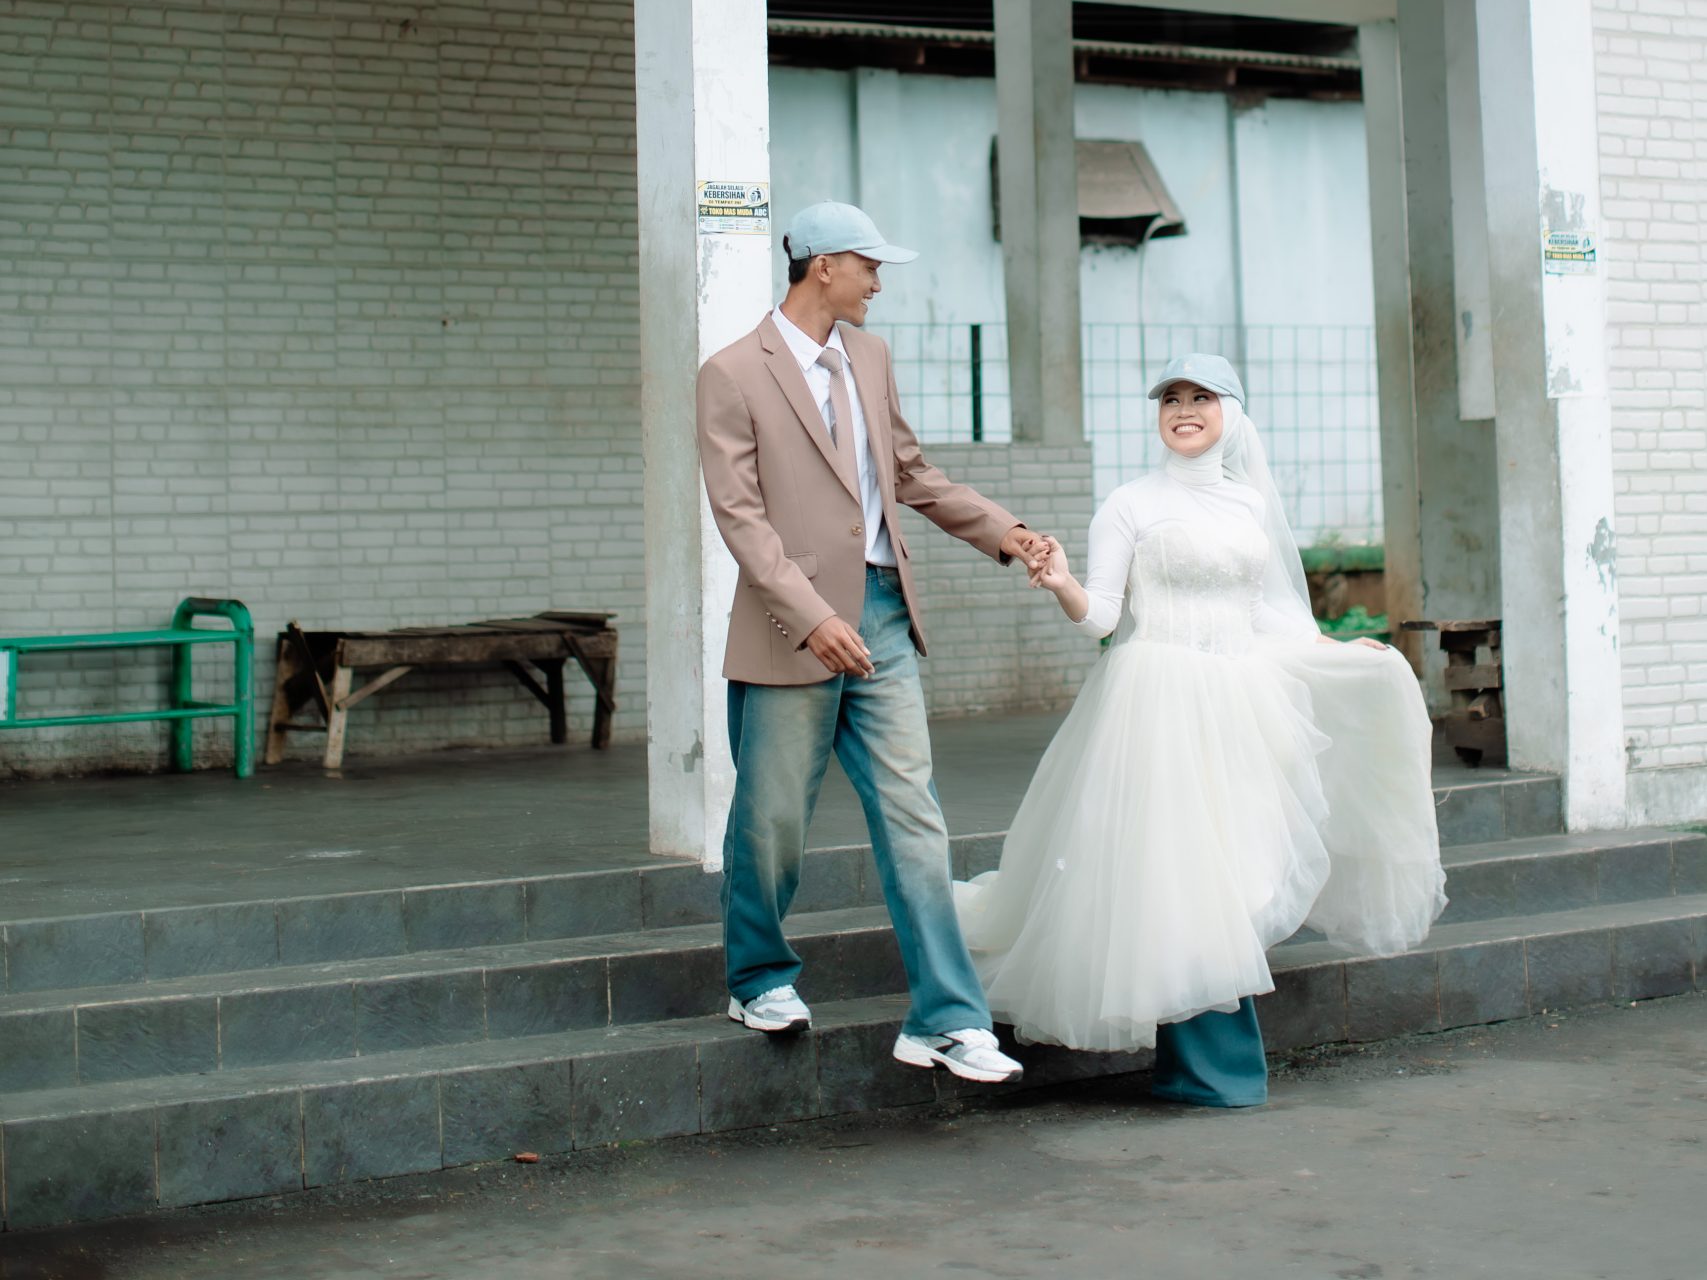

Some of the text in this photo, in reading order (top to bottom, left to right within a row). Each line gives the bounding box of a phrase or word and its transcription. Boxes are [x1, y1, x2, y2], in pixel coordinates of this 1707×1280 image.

[704, 191, 745, 199] KEBERSIHAN
[708, 207, 723, 216] TOKO
[724, 208, 736, 216] MAS
[754, 208, 767, 216] ABC
